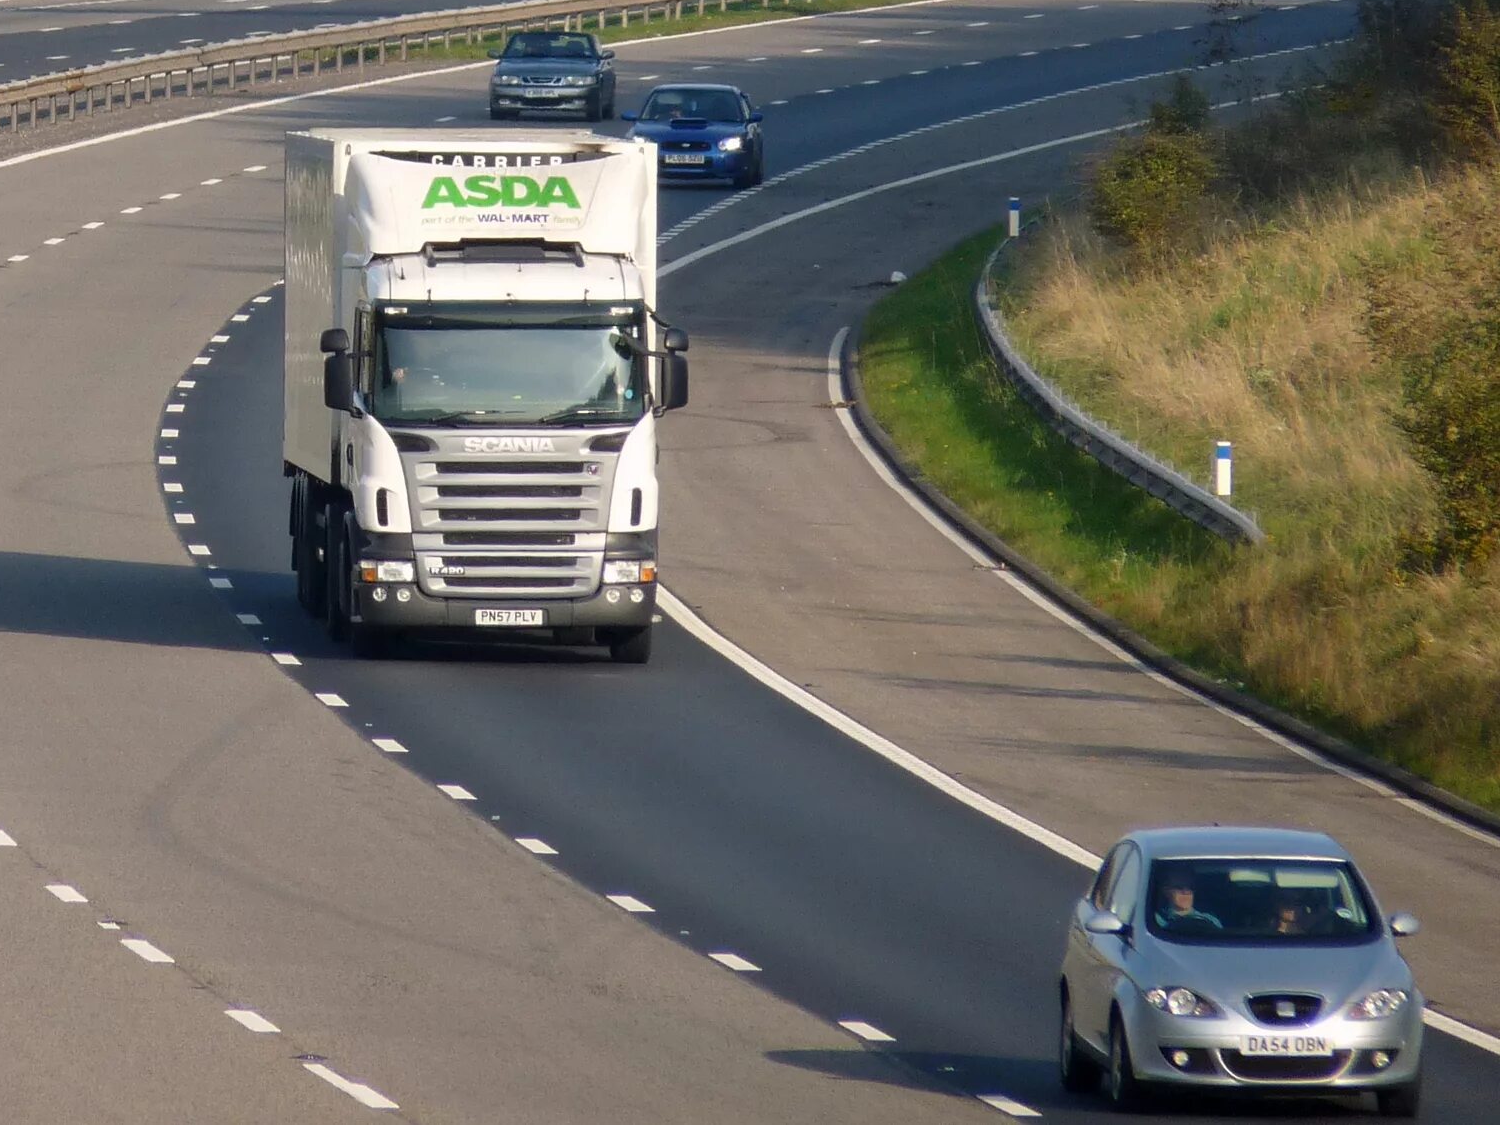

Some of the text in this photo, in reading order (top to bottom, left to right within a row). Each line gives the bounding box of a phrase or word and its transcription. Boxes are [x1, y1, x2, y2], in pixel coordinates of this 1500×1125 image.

[431, 155, 563, 168] CARRIER
[421, 175, 581, 209] ASDA
[464, 436, 556, 453] SCANIA
[481, 610, 537, 622] PN57 PLV
